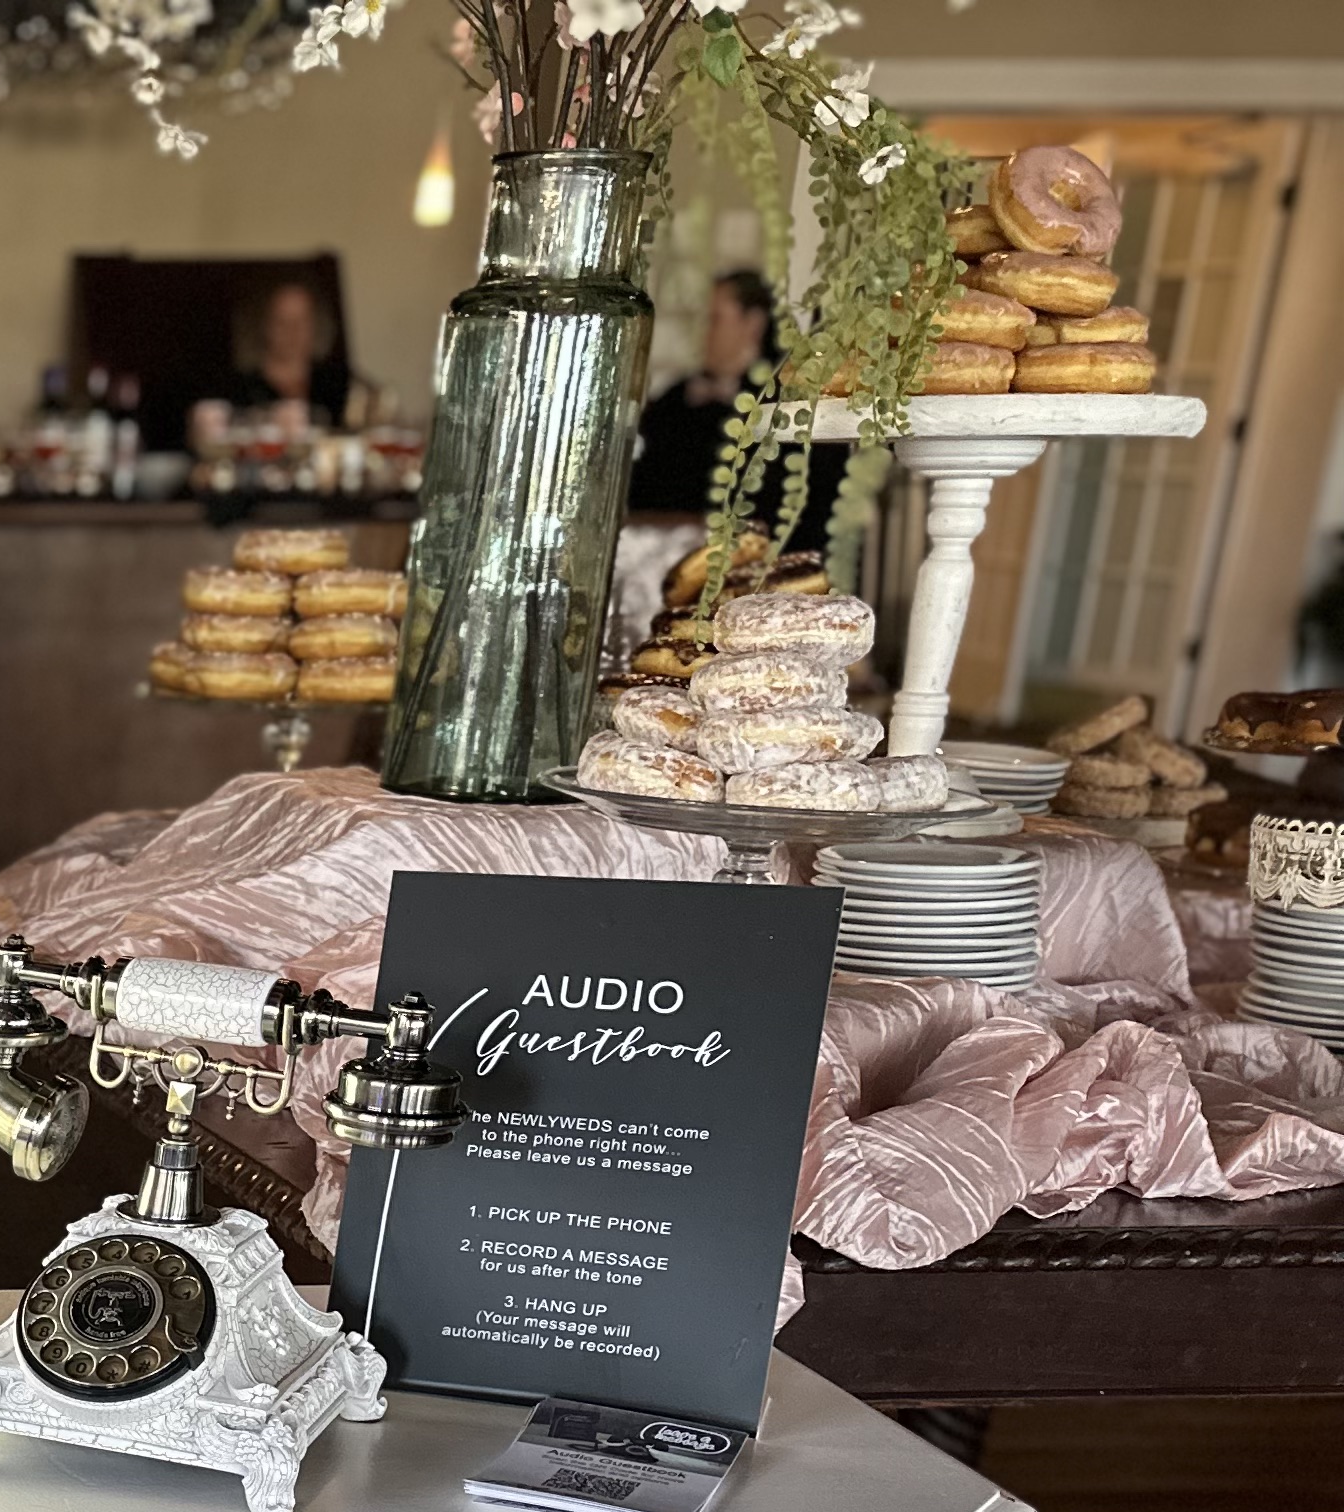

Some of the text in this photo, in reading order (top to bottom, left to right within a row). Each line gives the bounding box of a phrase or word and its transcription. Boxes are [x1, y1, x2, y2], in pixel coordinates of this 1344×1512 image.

[522, 974, 684, 1014] AUDIO
[476, 1008, 731, 1076] Guestbook
[471, 1110, 710, 1140] he NEWLYWEDS can't come
[482, 1129, 681, 1156] to the phone right now...
[466, 1144, 693, 1176] Please leave us a message
[469, 1205, 673, 1235] 1. PICK UP THE PHONE
[460, 1239, 669, 1271] 2. RECORD A MESSAGE
[480, 1258, 642, 1286] for us after the tone
[504, 1296, 607, 1317] 3. HANG UP
[476, 1310, 631, 1338] (Your message will
[441, 1325, 660, 1361] automatically be recorded)
[547, 1450, 686, 1478] Audio Guestbook
